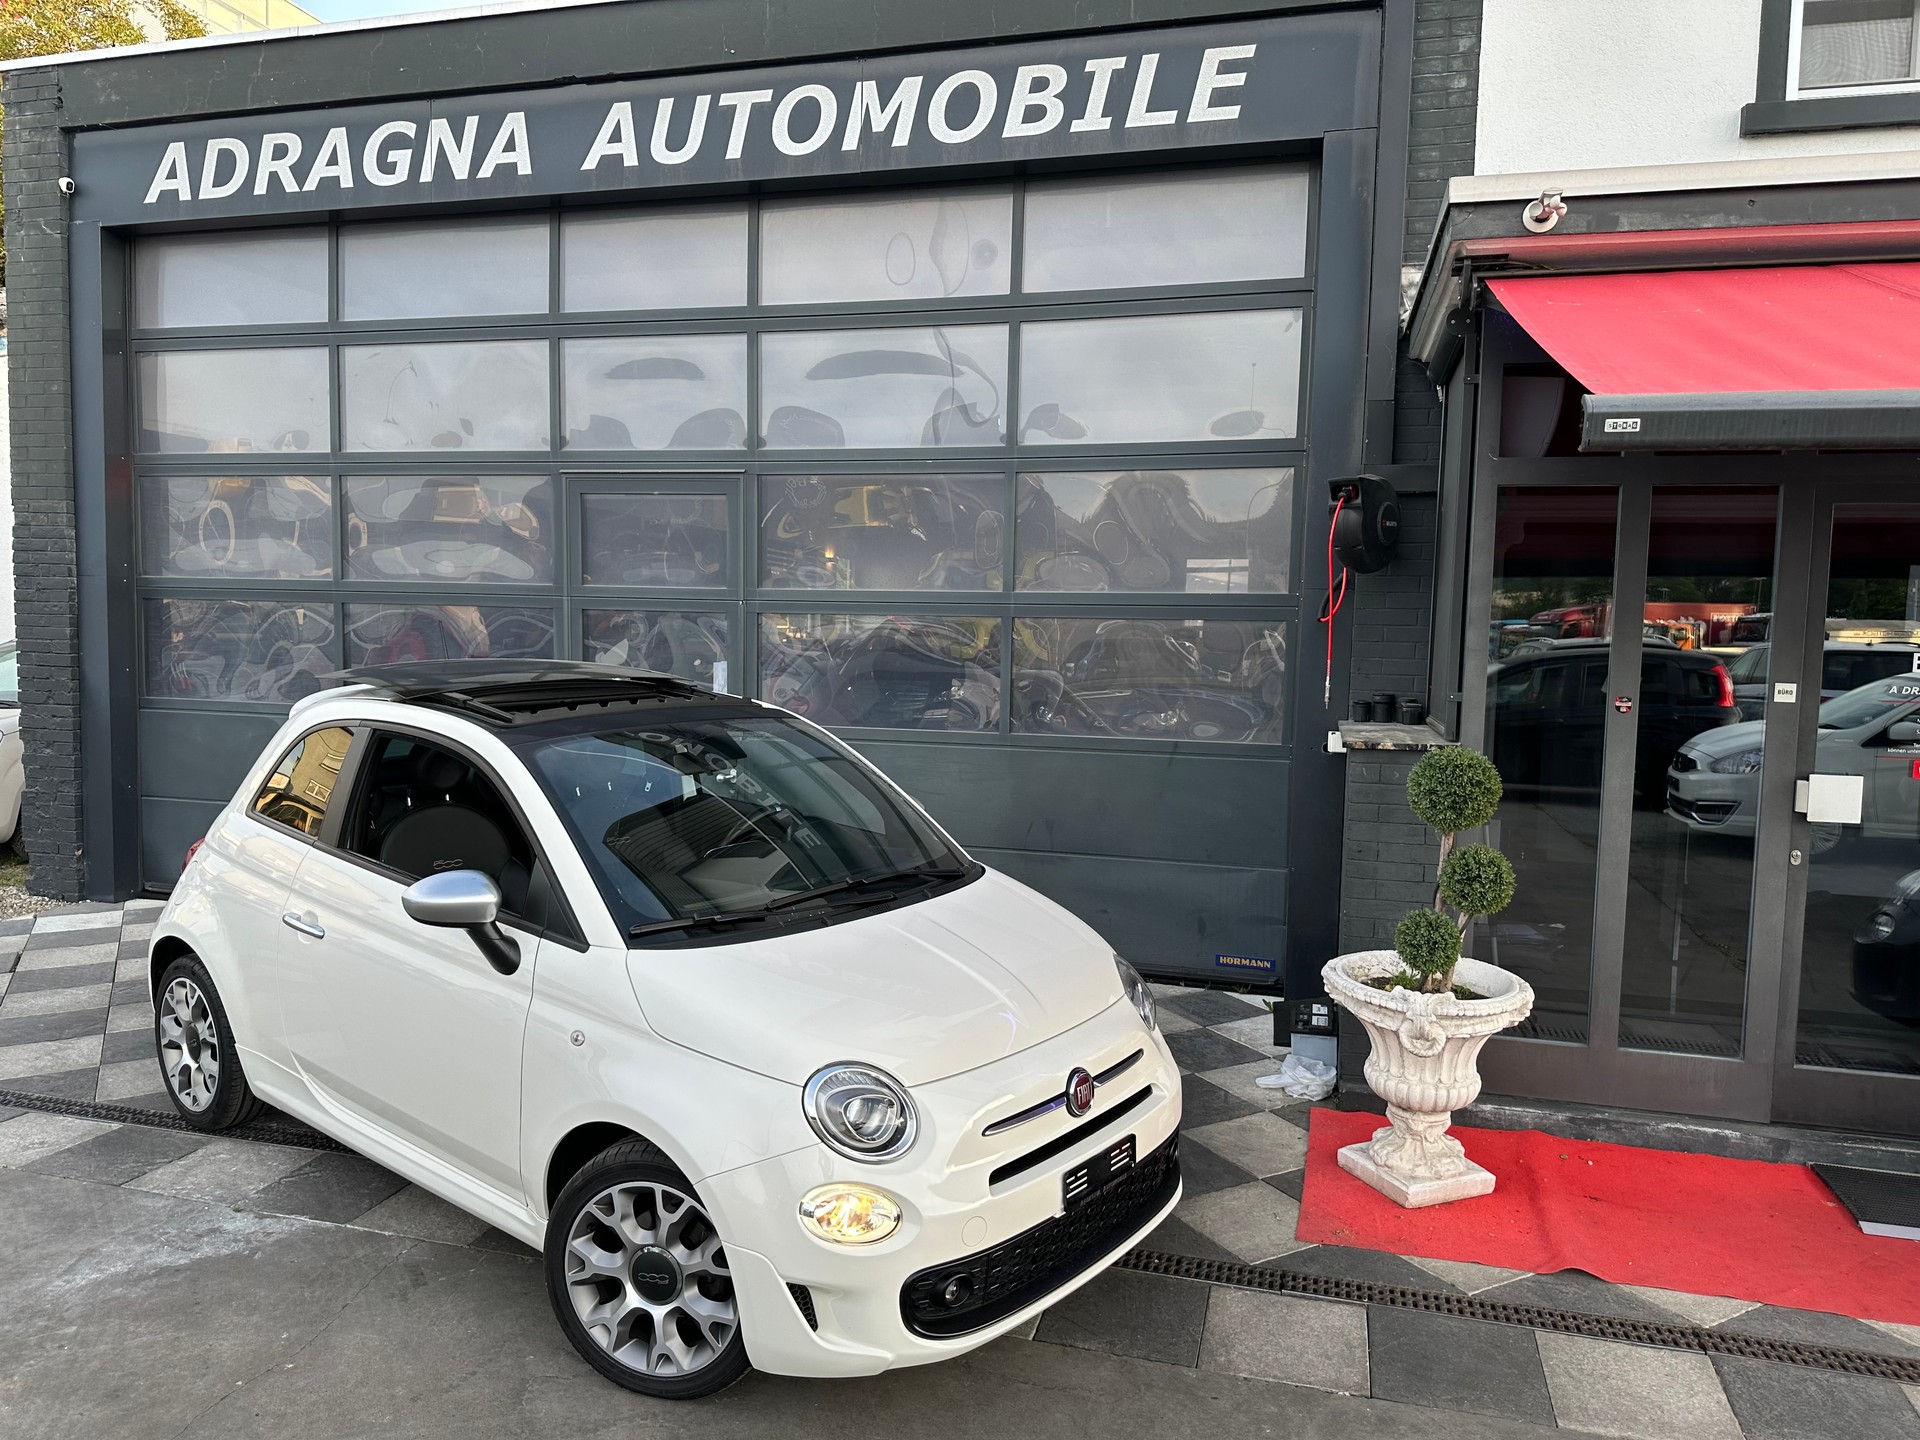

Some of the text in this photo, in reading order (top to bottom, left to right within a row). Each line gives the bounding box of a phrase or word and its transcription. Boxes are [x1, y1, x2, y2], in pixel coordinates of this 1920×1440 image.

[143, 43, 1258, 204] ADRAGNA AUTOMOBILE
[1777, 688, 1794, 696] BÜRO
[1077, 1081, 1092, 1105] FIAT
